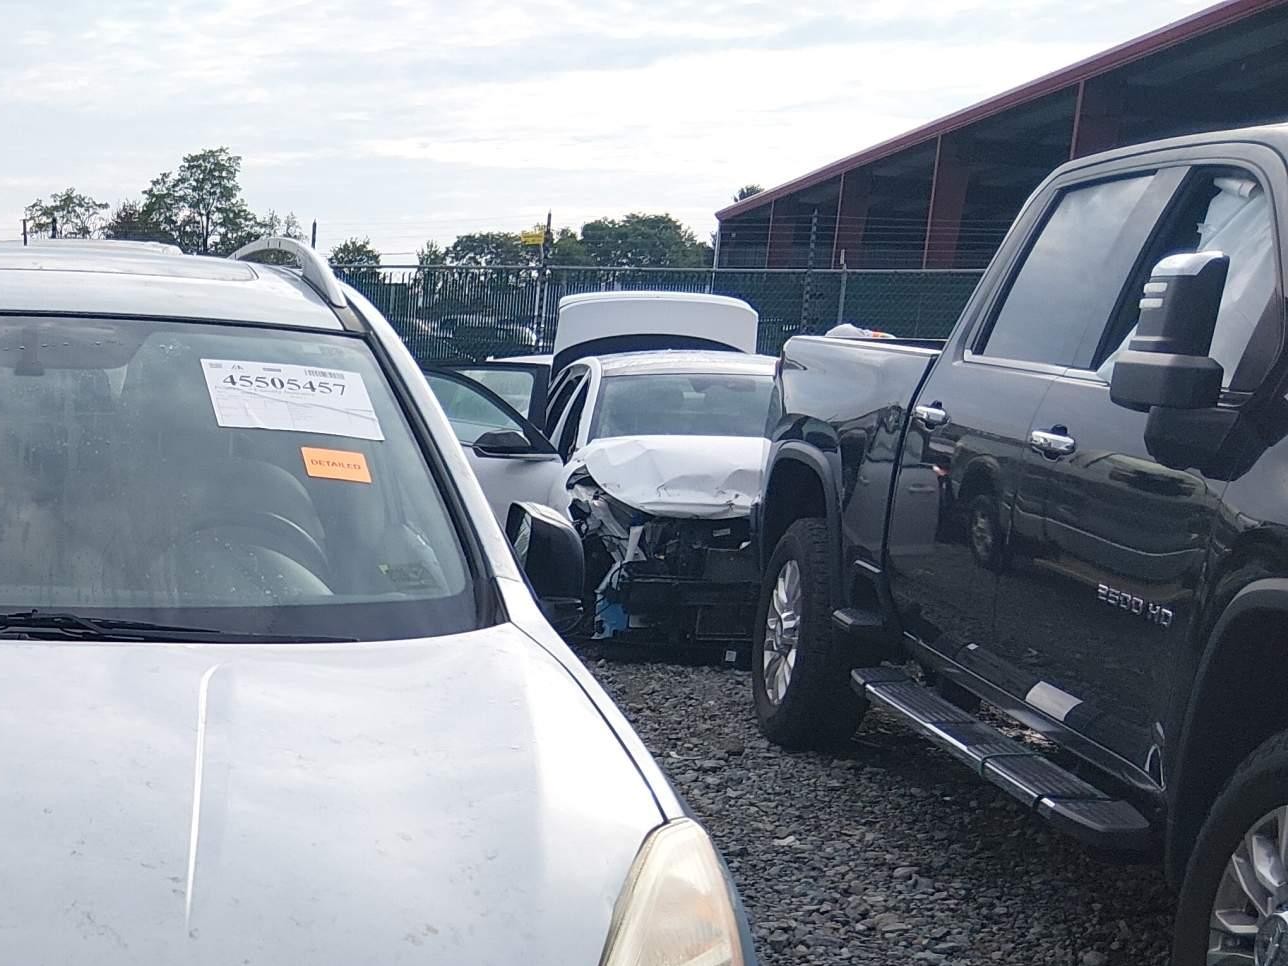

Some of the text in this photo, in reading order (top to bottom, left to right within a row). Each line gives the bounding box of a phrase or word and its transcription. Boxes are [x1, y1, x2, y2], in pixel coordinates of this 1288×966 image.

[222, 374, 346, 396] 45505457
[310, 458, 362, 470] DETAILED
[1097, 583, 1174, 628] 2500 HD
